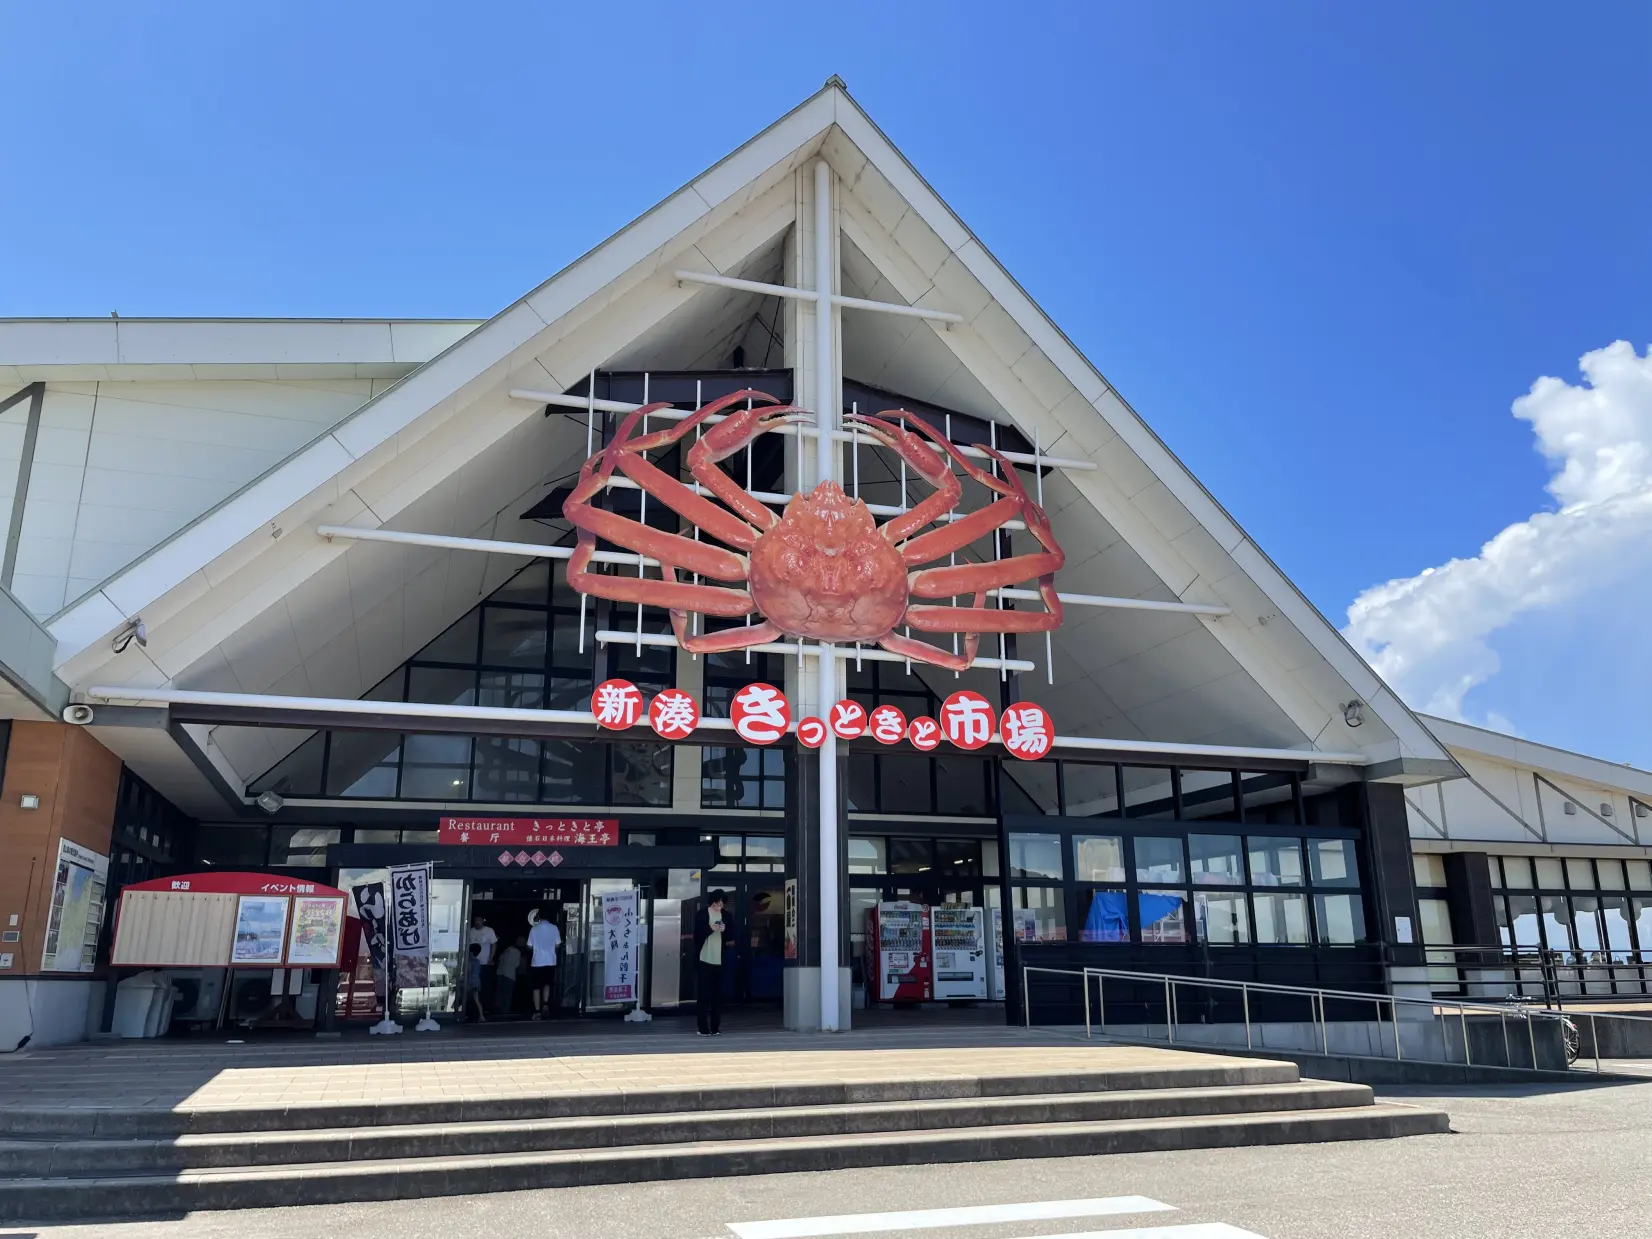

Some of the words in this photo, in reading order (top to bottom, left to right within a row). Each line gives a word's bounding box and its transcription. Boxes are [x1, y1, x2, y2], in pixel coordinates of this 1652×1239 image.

[448, 819, 515, 831] Restaurant
[532, 820, 605, 832] きっときと亭
[171, 881, 191, 890] 歓迎
[261, 884, 315, 893] イベント情報
